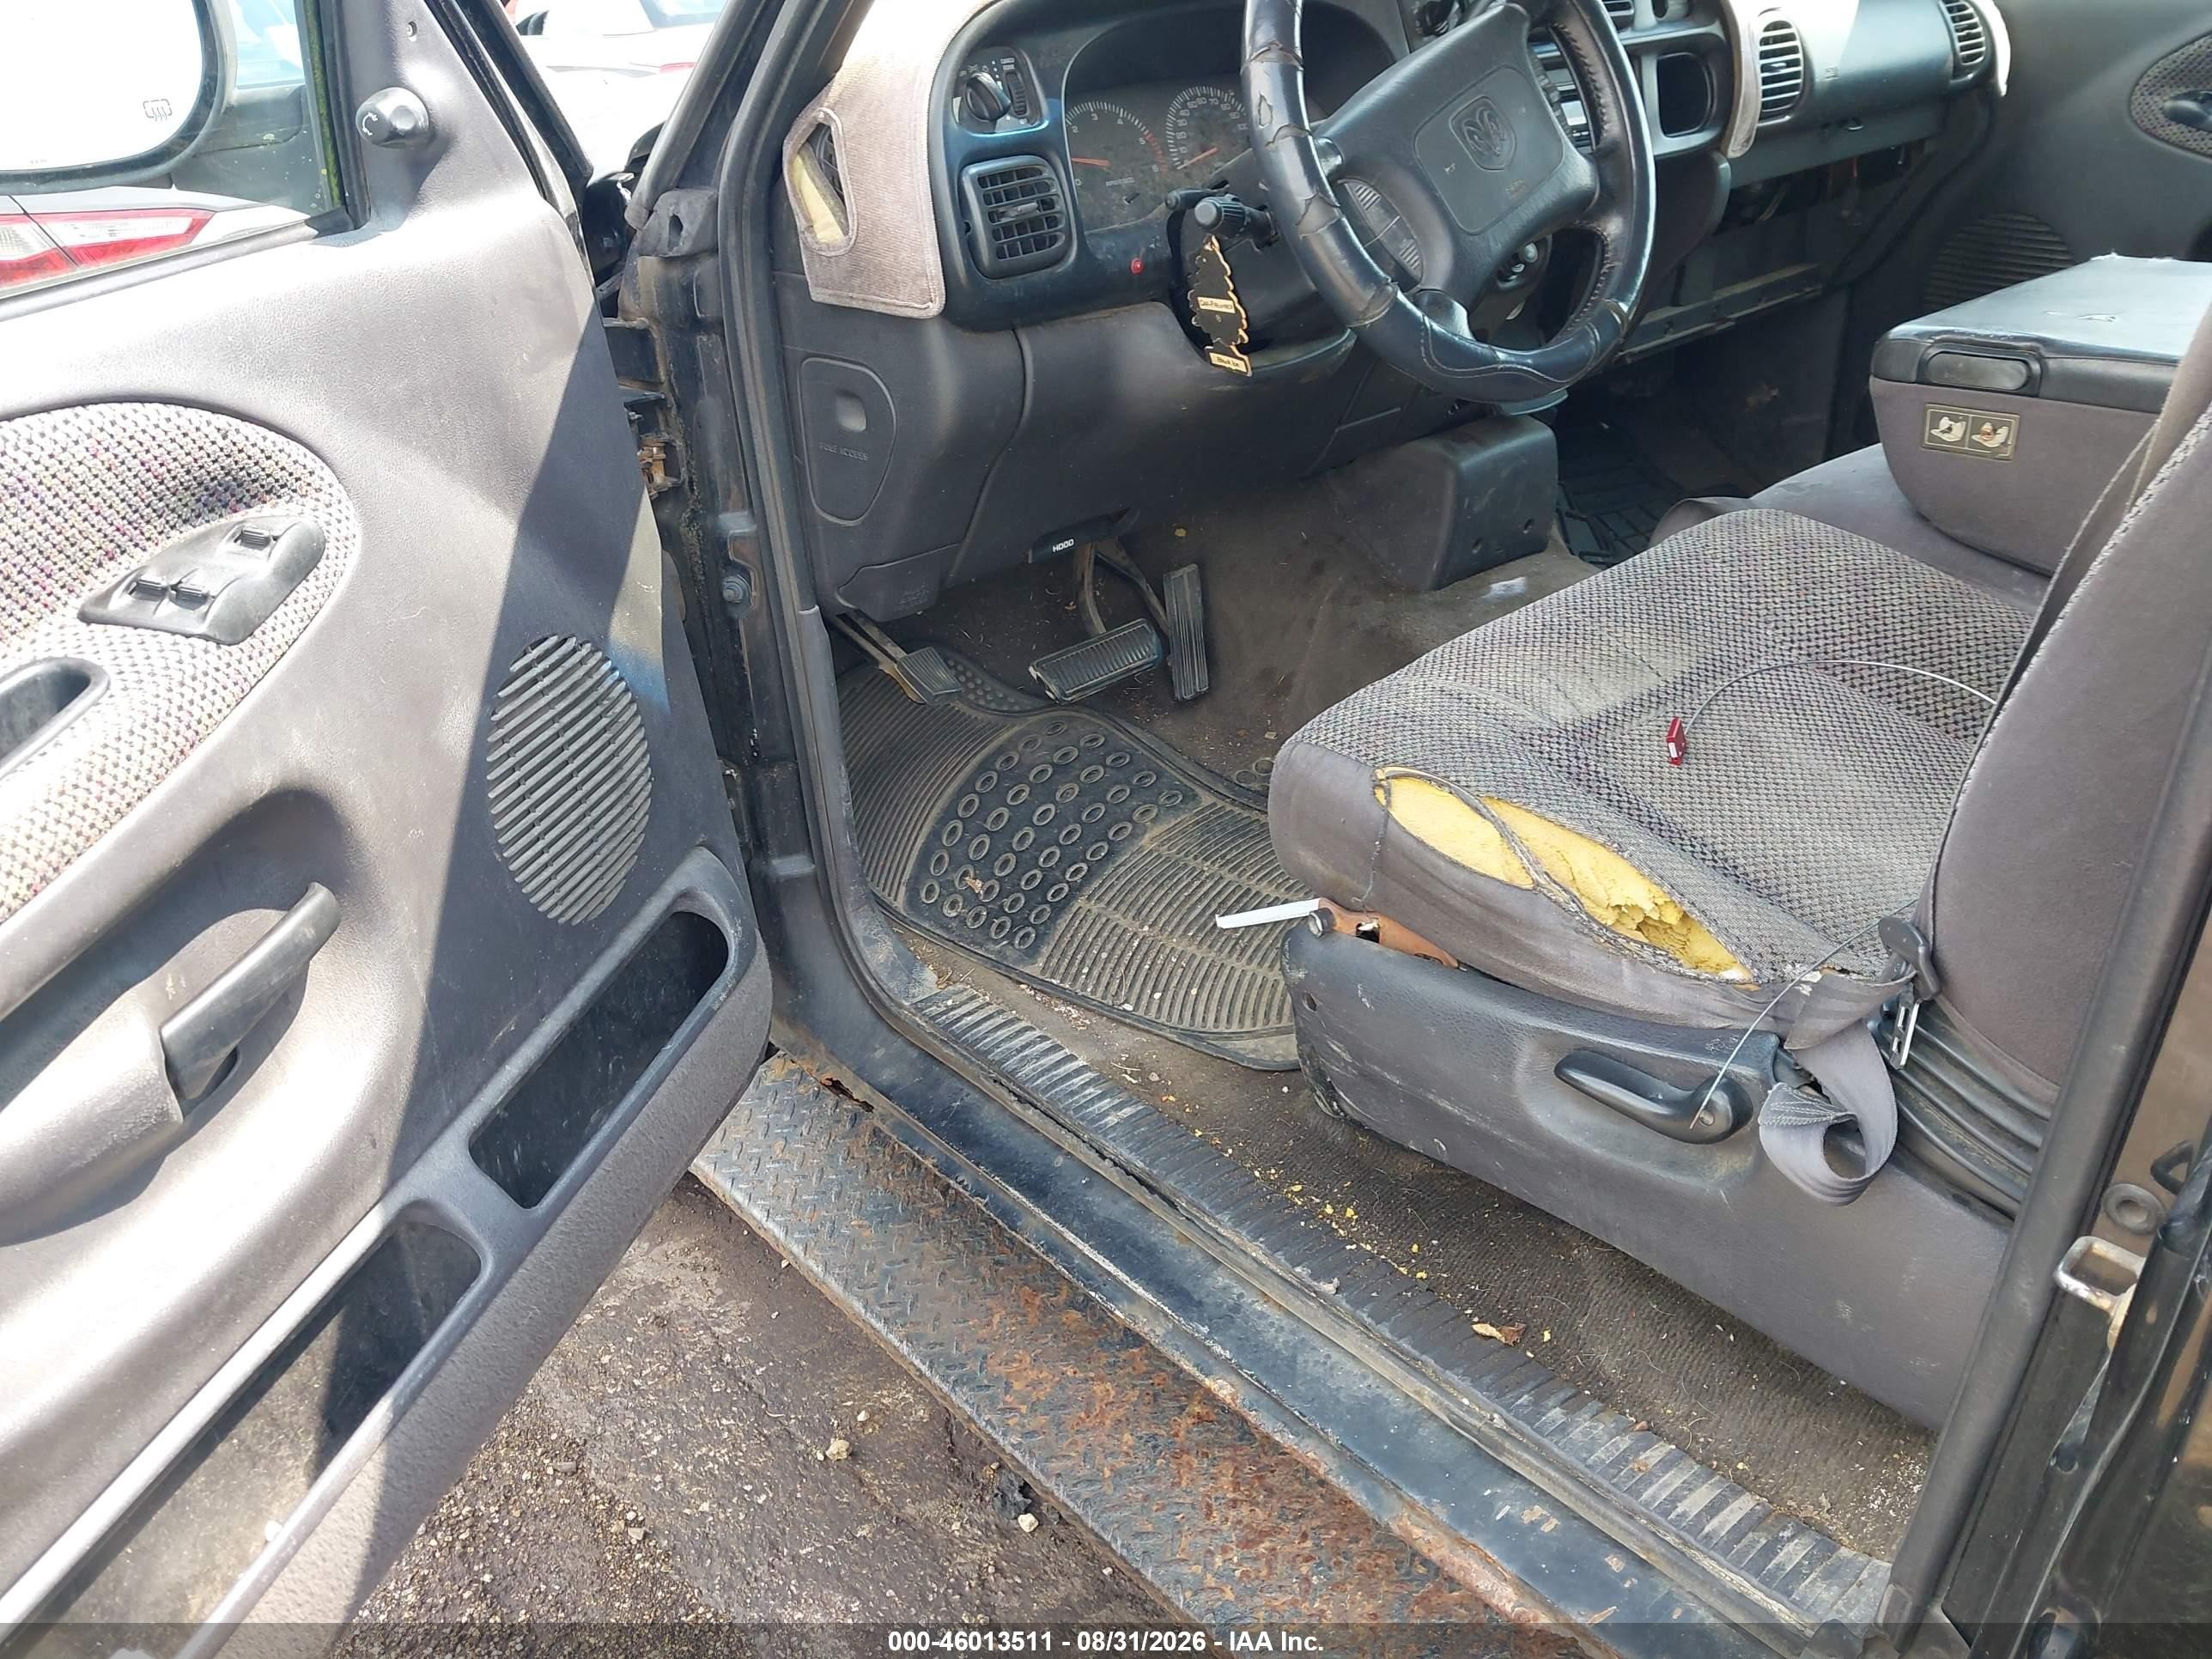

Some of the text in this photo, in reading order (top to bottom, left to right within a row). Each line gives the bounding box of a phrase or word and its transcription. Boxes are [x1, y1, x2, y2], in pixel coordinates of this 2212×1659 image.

[1091, 112, 1099, 121] 3
[1071, 125, 1079, 134] 2
[1138, 137, 1146, 145] 5
[1152, 163, 1159, 173] 6
[1074, 178, 1083, 186] 0
[1052, 538, 1075, 553] HOOD
